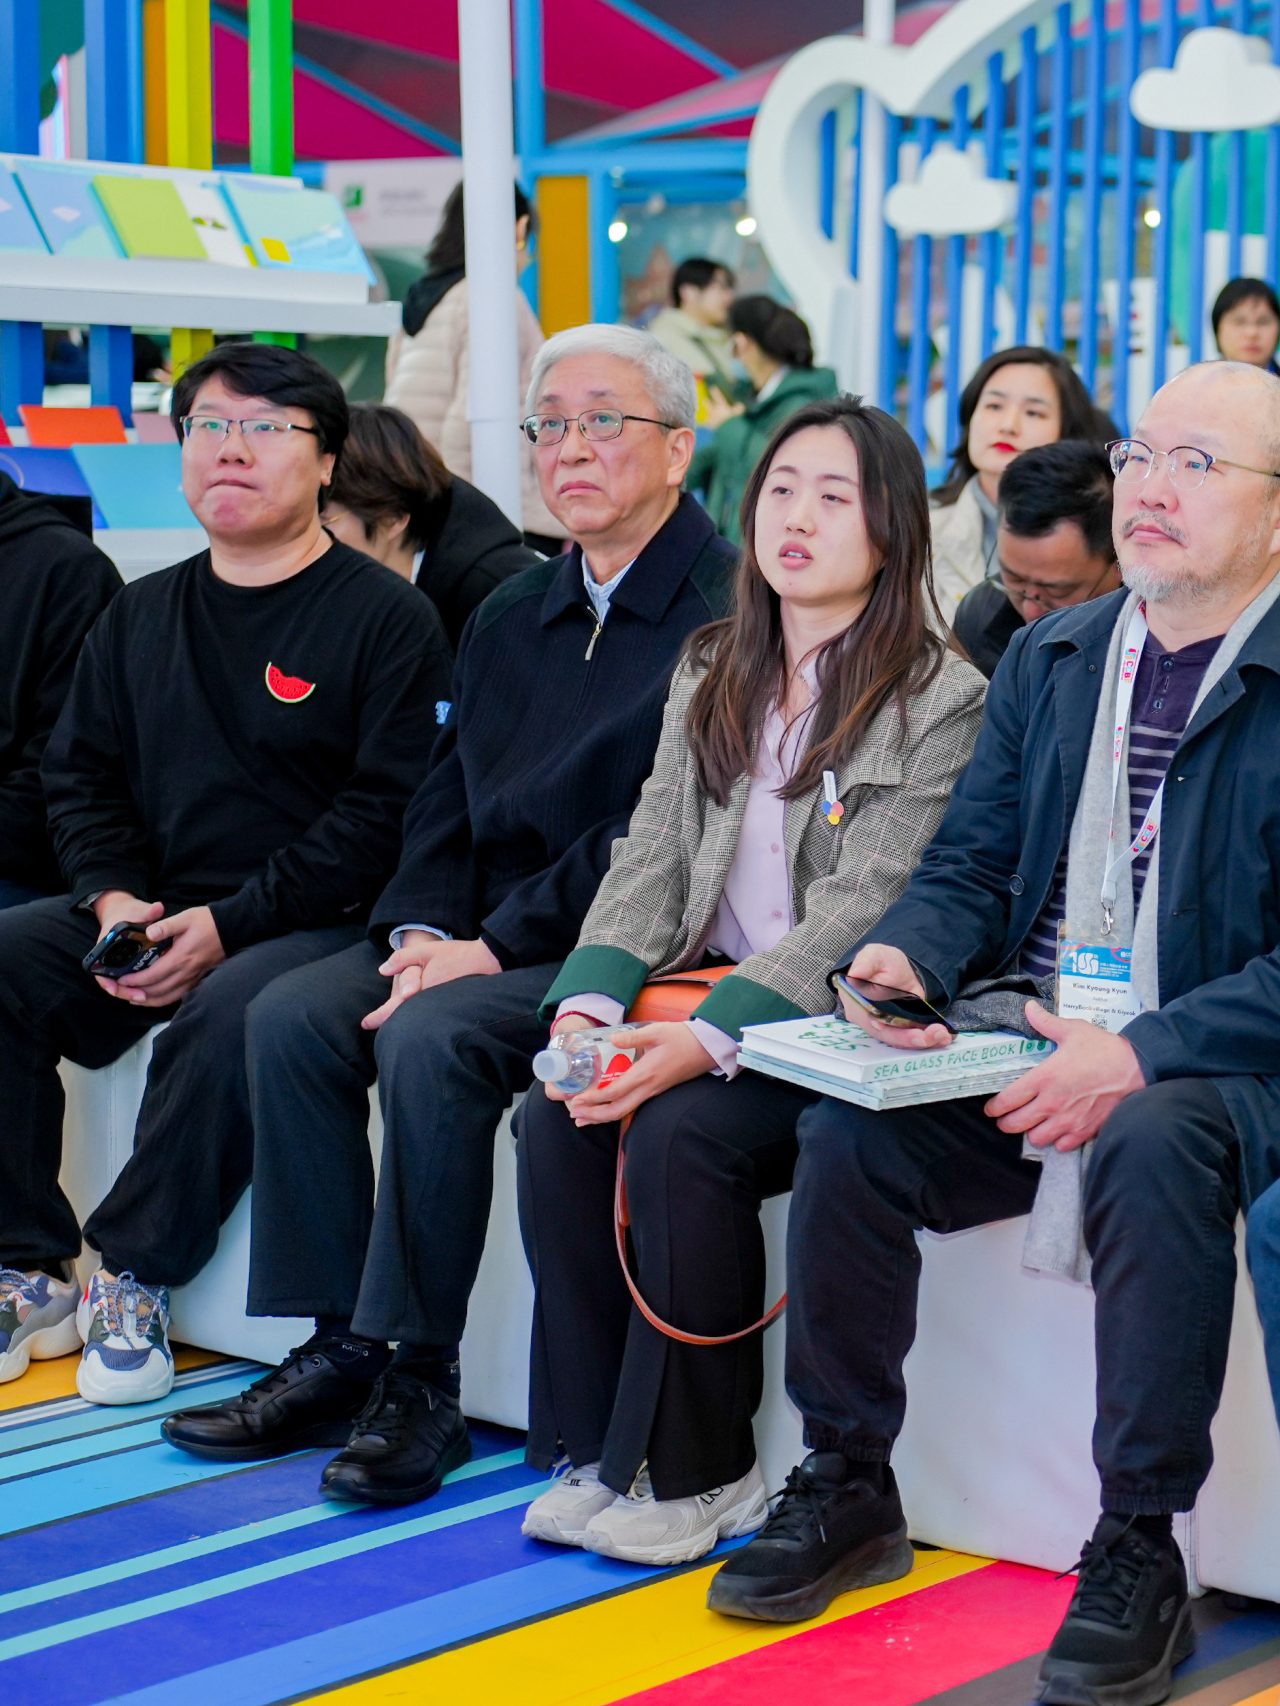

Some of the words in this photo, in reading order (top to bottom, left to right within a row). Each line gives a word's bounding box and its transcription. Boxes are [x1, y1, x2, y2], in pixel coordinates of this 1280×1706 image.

[874, 1063, 899, 1079] SEA
[904, 1055, 944, 1072] GLASS
[948, 1050, 978, 1065] FACE
[981, 1043, 1016, 1060] BOOK
